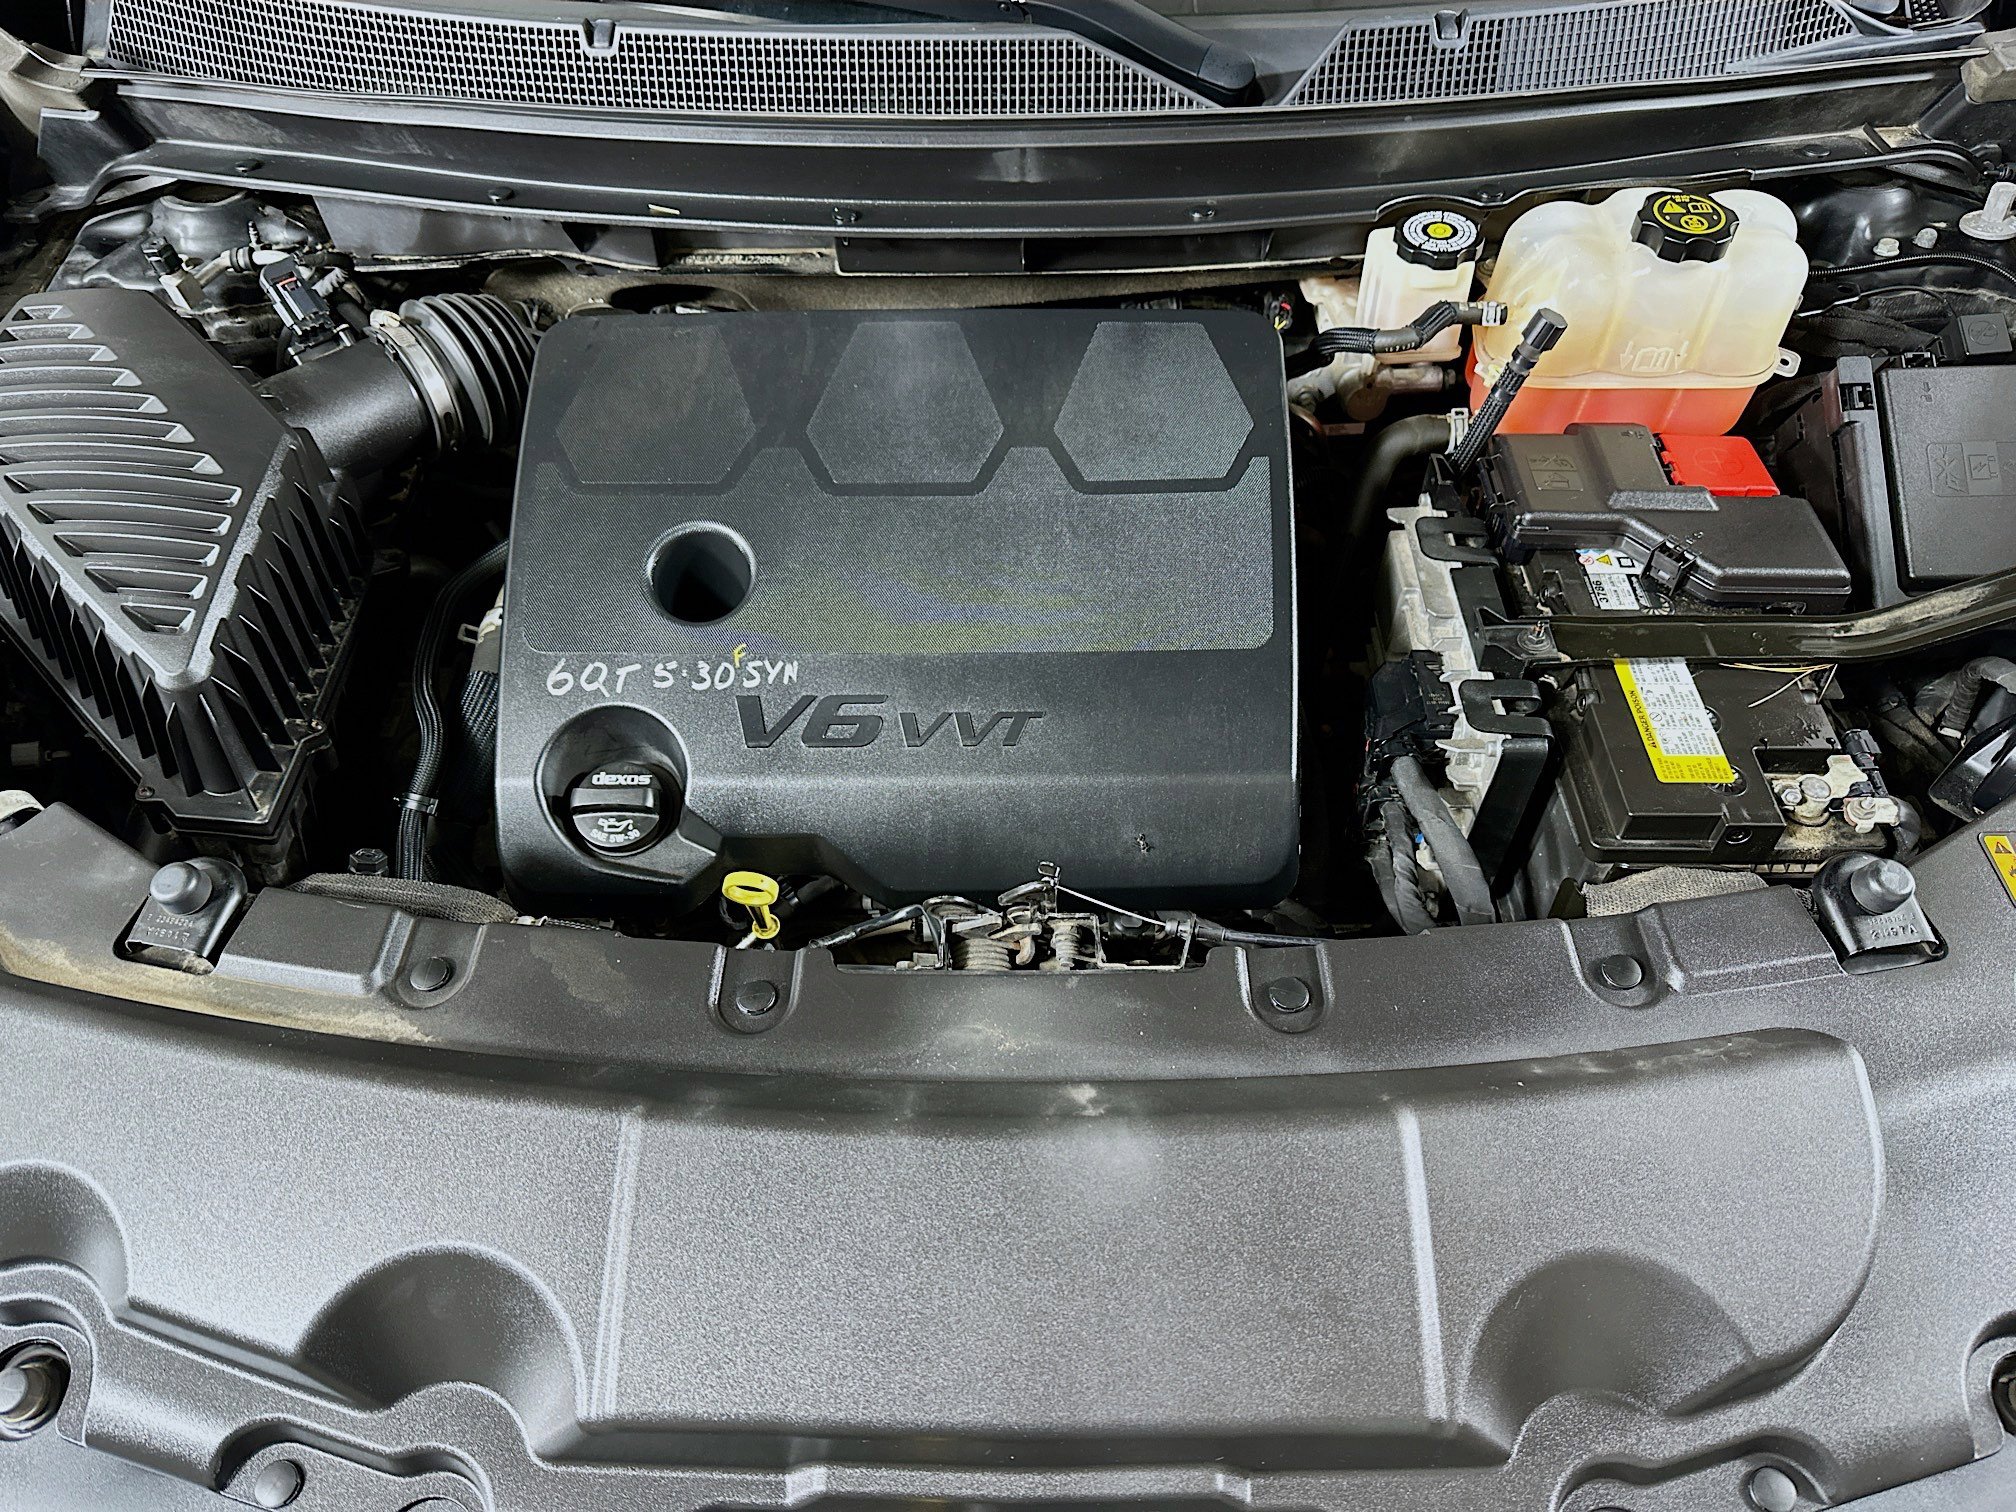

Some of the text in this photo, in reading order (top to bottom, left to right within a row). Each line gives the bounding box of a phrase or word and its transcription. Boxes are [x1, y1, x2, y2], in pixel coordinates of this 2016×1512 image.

[1592, 580, 1609, 603] 3786
[546, 657, 642, 697] 6QT
[742, 660, 799, 688] SYN
[735, 695, 1046, 748] V6 VVT
[1629, 690, 1655, 742] DANGER POISON
[591, 771, 653, 786] dexos
[589, 828, 641, 843] SAE 5W-30
